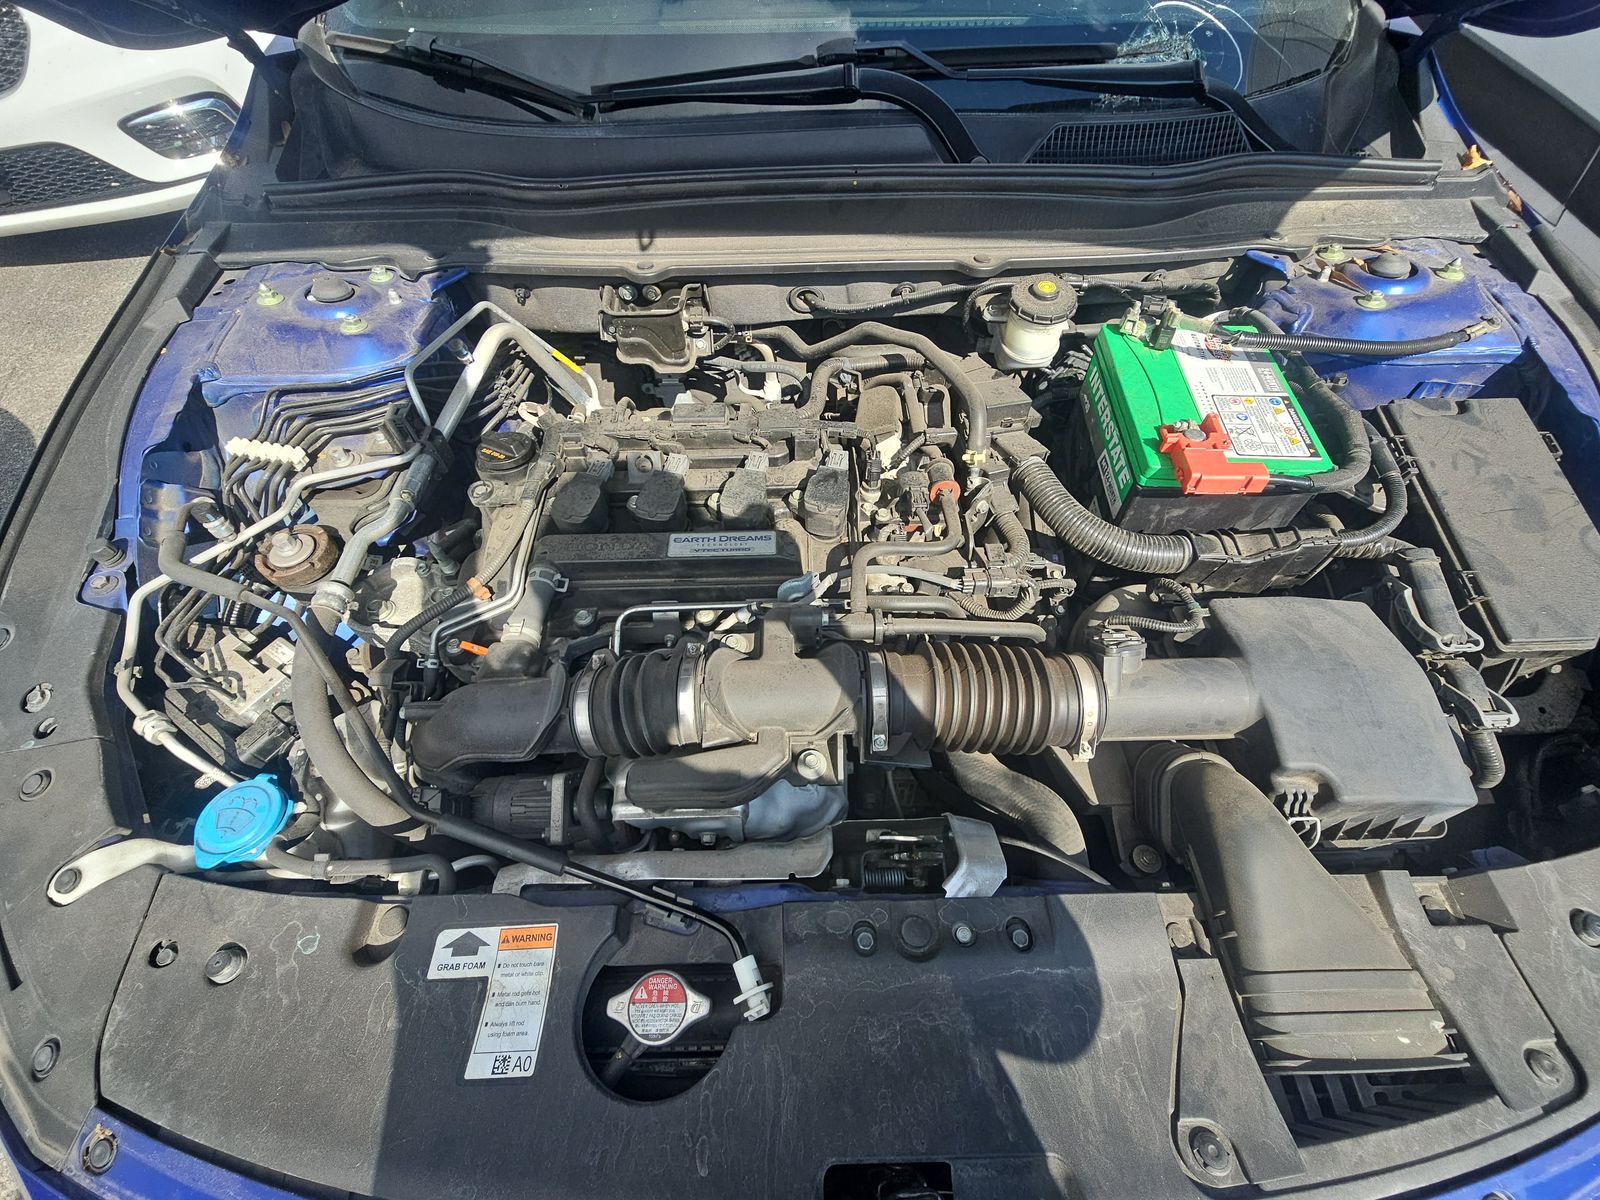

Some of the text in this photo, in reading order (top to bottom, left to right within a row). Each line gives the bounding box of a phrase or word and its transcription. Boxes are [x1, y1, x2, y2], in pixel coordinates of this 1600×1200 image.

[1090, 366, 1130, 489] INTERSTATE
[719, 535, 772, 543] DREAMS
[511, 933, 553, 943] WARNING
[437, 961, 486, 971] GRAB FOAM
[511, 1055, 532, 1072] A0
